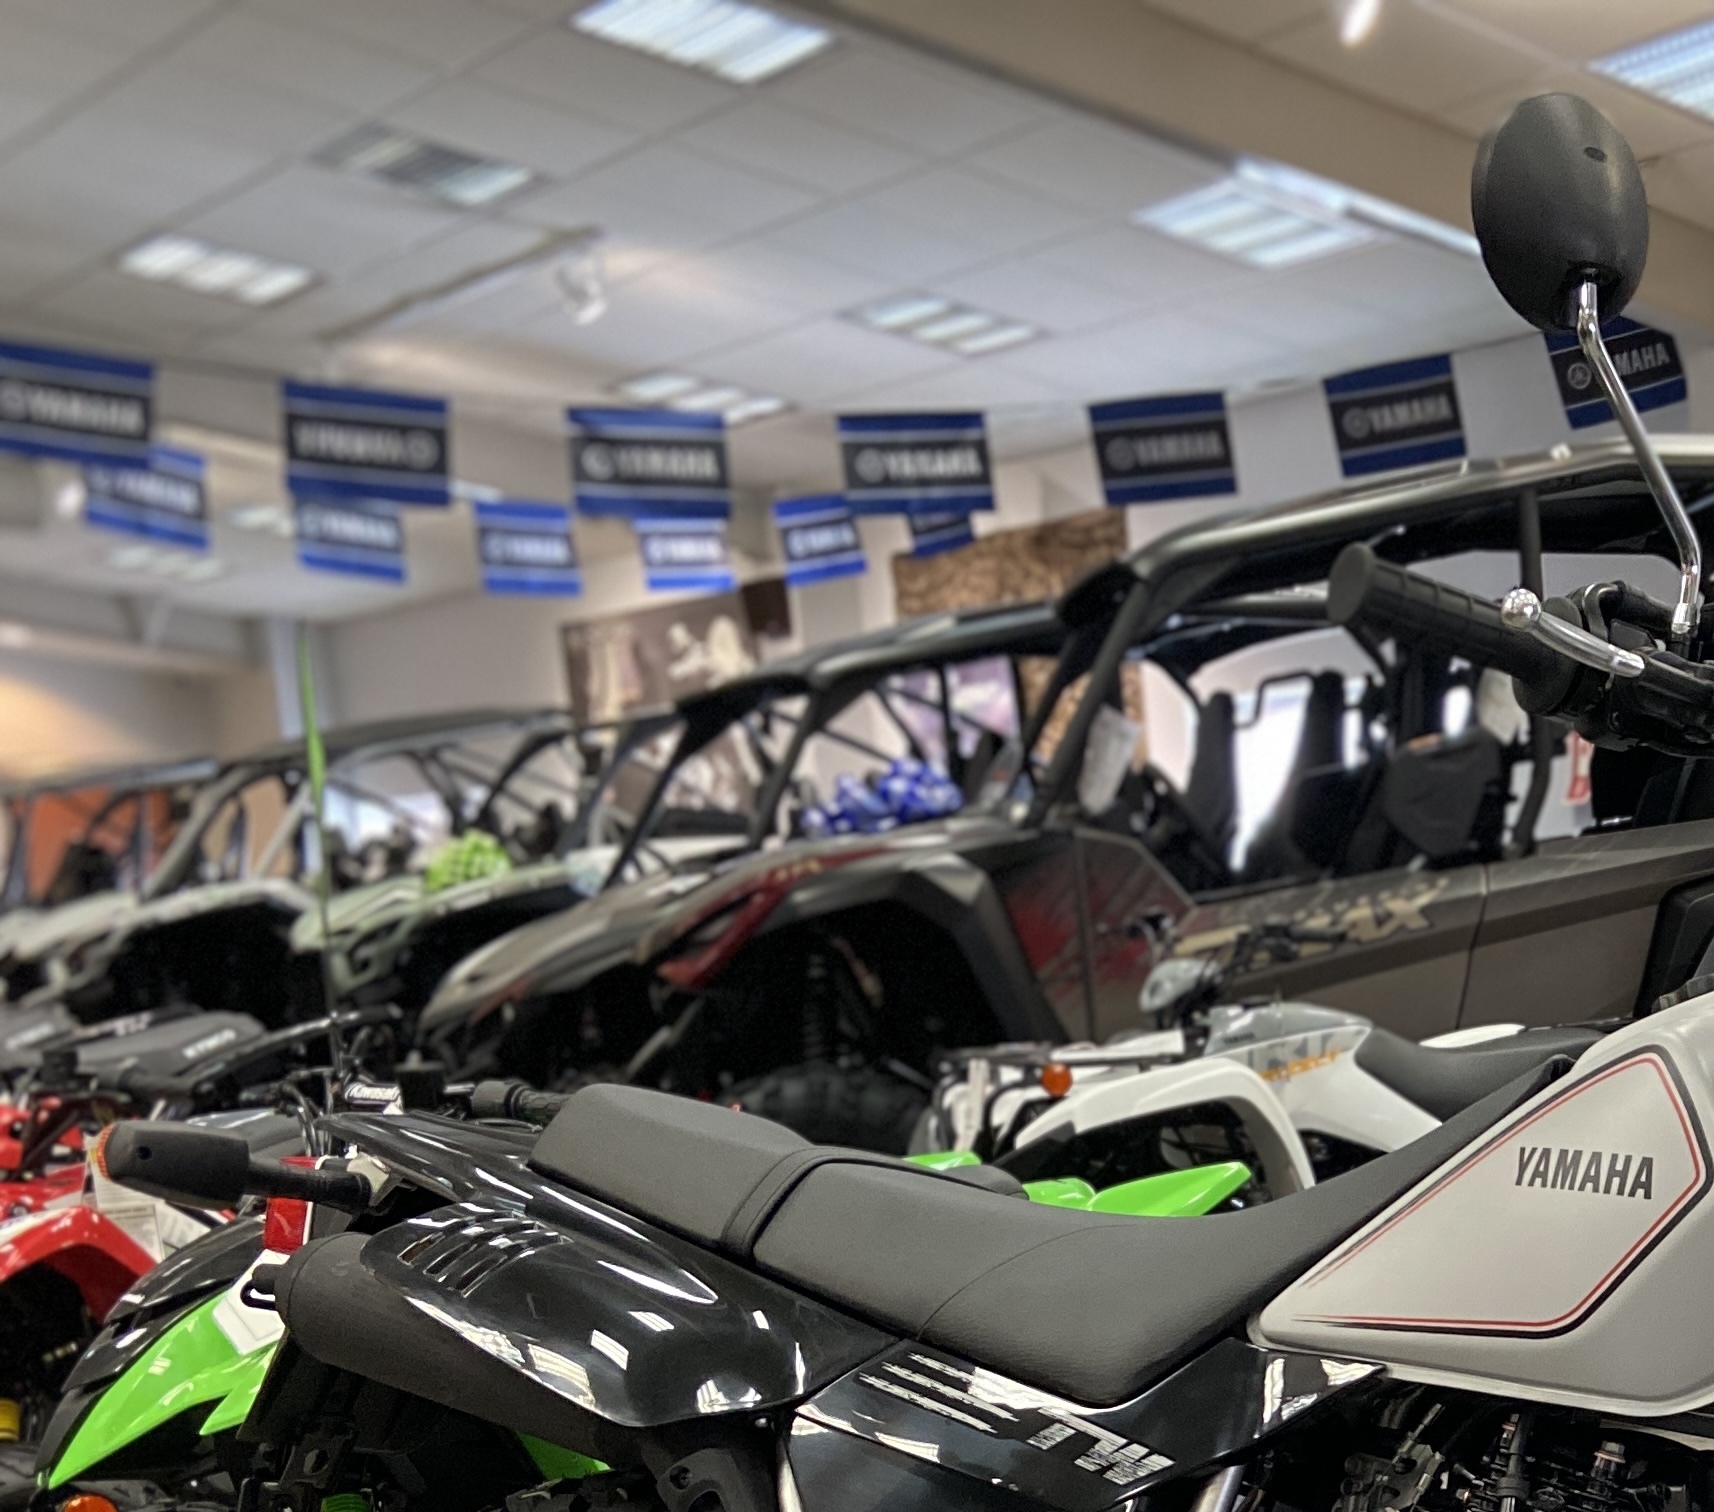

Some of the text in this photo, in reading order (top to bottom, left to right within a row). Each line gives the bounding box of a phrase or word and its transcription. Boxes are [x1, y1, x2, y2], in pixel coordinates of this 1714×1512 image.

[1610, 342, 1671, 376] MAHA
[1370, 394, 1454, 432] YAMAHA
[883, 447, 983, 480] YAMAHA
[1136, 431, 1225, 466] YAMAHA
[1515, 1146, 1654, 1200] YAMAHA
